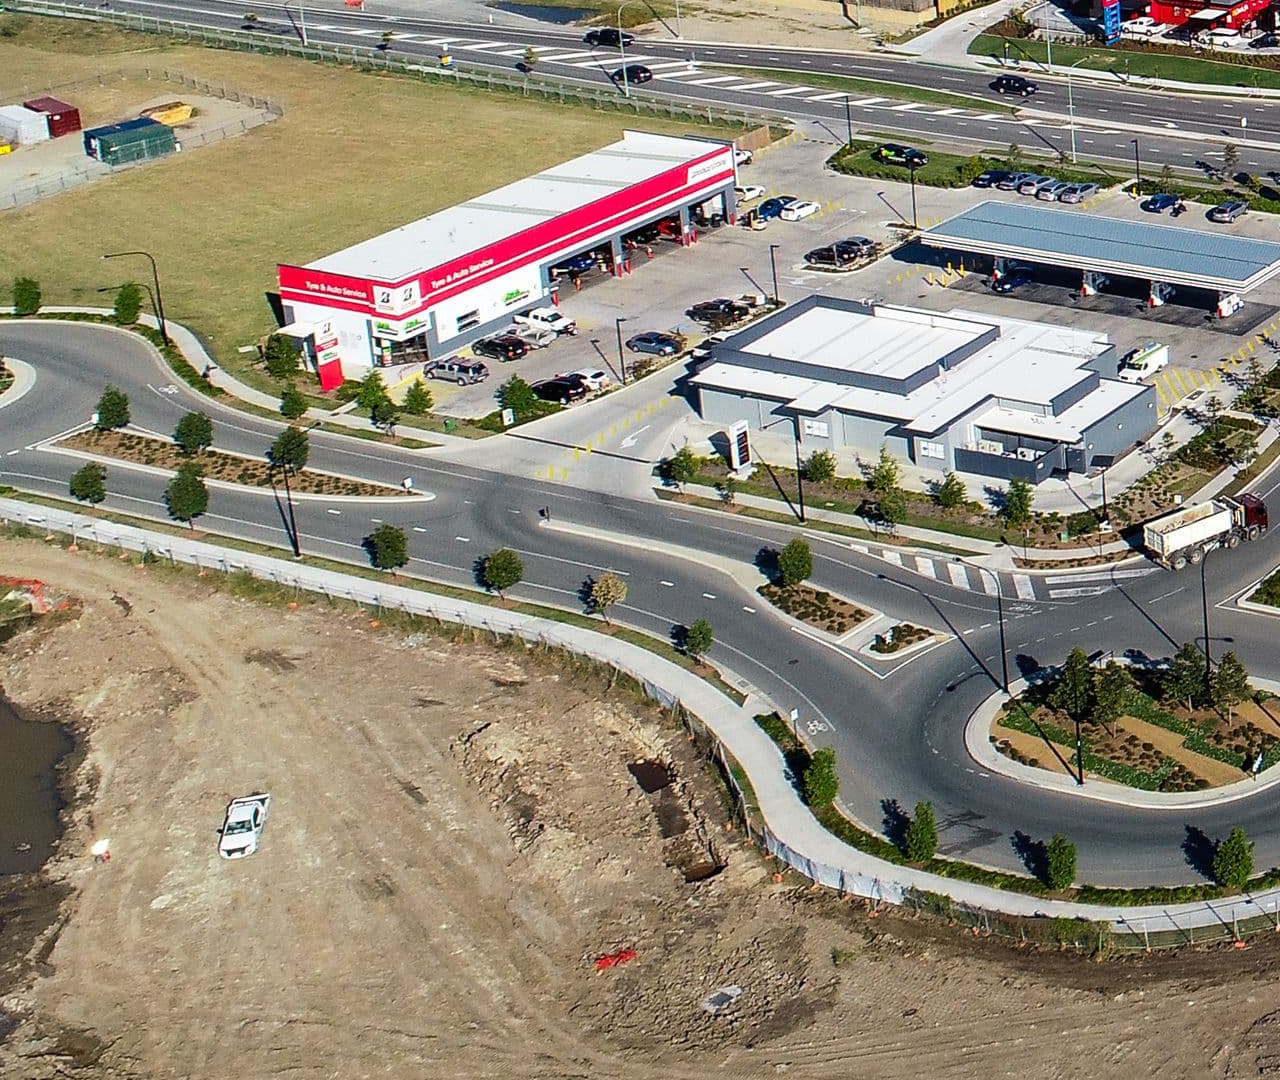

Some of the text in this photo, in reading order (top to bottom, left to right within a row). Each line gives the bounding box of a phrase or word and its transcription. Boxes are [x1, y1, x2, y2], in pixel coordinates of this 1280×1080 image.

[430, 278, 446, 289] Tyre
[452, 268, 469, 280] Auto
[469, 258, 494, 273] Service
[304, 281, 320, 291] Tyre
[327, 285, 342, 294] Auto
[342, 288, 367, 298] Service
